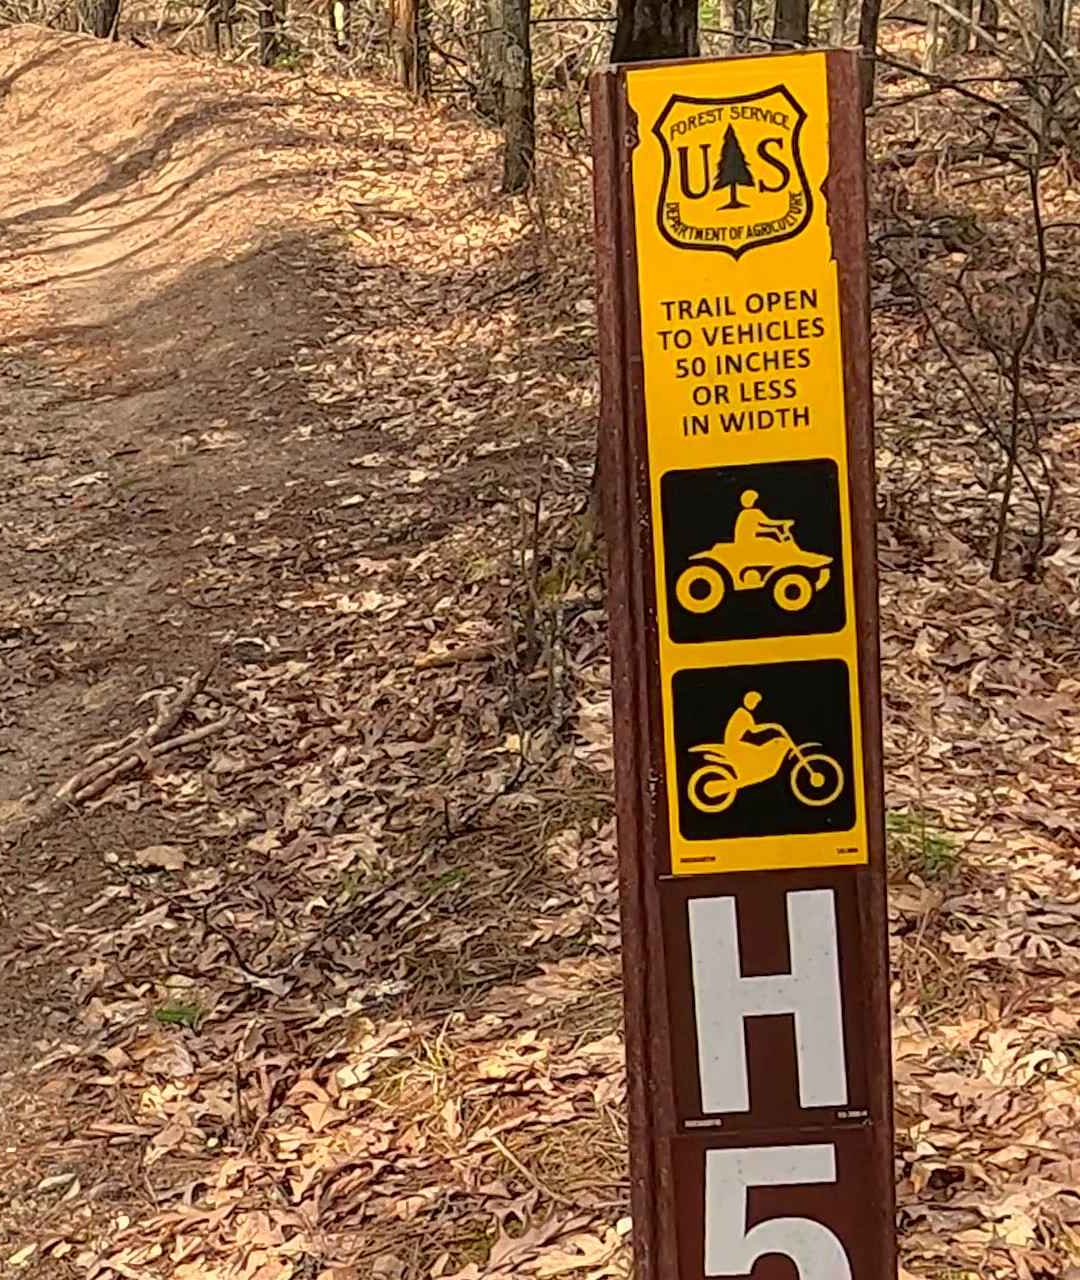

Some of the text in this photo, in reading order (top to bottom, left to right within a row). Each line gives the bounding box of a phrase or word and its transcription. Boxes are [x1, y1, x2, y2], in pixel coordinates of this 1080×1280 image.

[670, 106, 791, 140] FOREST SERVICE
[666, 191, 802, 241] DEPARTMENT OF AGRICULTURE
[660, 288, 817, 321] TRAIL OPEN
[657, 317, 825, 350] TO VEHICLES
[676, 348, 810, 378] 50 INCHES
[693, 378, 796, 406] OR LESS
[683, 406, 810, 436] IN WIDTH
